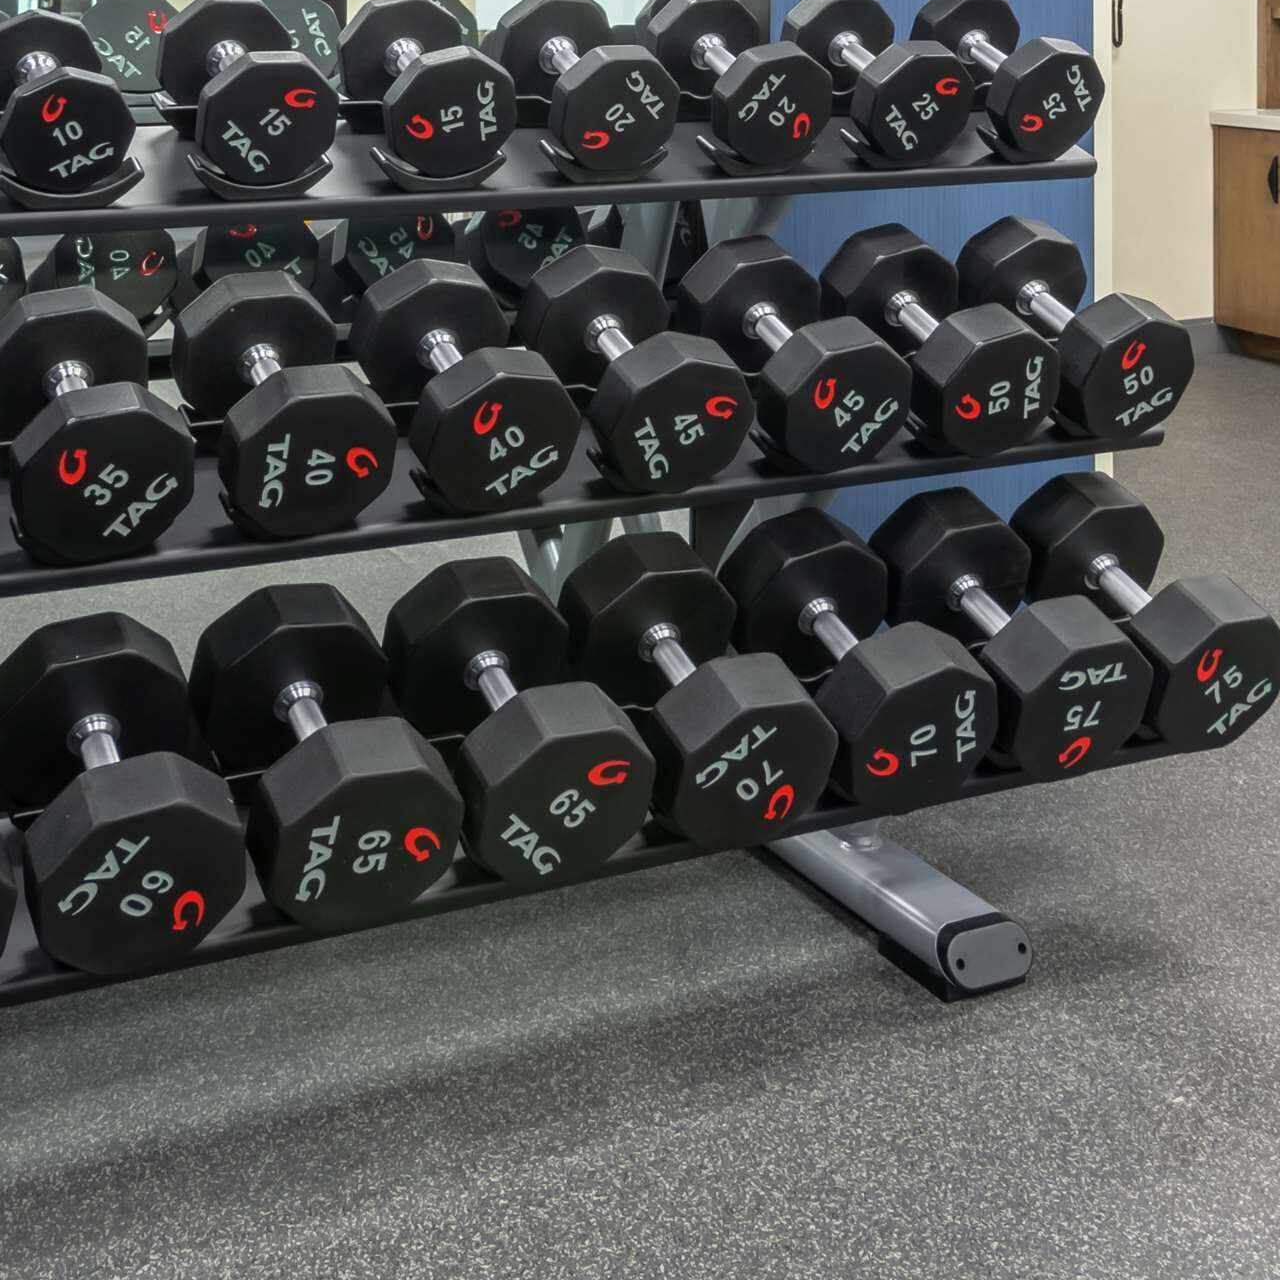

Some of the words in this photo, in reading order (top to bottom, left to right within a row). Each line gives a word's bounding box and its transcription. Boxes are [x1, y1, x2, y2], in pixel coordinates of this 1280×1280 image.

[625, 69, 665, 120] TAG
[737, 73, 787, 122] TAG
[911, 93, 940, 121] 25
[1042, 92, 1067, 119] 25
[1066, 64, 1092, 112] TAG
[258, 108, 293, 136] 15
[439, 105, 465, 134] 15
[476, 80, 498, 142] TAG
[604, 103, 636, 133] 20
[768, 95, 796, 127] 20
[885, 103, 919, 151] TAG
[52, 120, 83, 147] 10
[221, 119, 271, 173] TAG
[49, 141, 114, 178] TAG
[987, 380, 1011, 415] 50
[1023, 355, 1044, 420] TAG
[1123, 365, 1154, 395] 50
[834, 389, 865, 428] 45
[840, 397, 899, 453] TAG
[1114, 386, 1173, 427] TAG
[489, 426, 525, 462] 40
[634, 416, 669, 480] TAG
[674, 413, 705, 446] 45
[83, 463, 129, 506] 35
[258, 433, 291, 509] TAG
[304, 448, 336, 486] 40
[484, 444, 559, 496] TAG
[102, 472, 178, 537] TAG
[1058, 661, 1128, 691] TAG
[1204, 664, 1243, 705] 75
[954, 689, 977, 763] TAG
[1063, 700, 1102, 732] 75
[1206, 678, 1272, 735] TAG
[695, 724, 778, 789] TAG
[909, 724, 938, 768] 70
[735, 759, 784, 801] 70
[549, 788, 597, 828] 65
[295, 815, 341, 902] TAG
[352, 830, 392, 874] 65
[500, 813, 561, 876] TAG
[57, 836, 150, 916] TAG
[119, 870, 174, 917] 60
